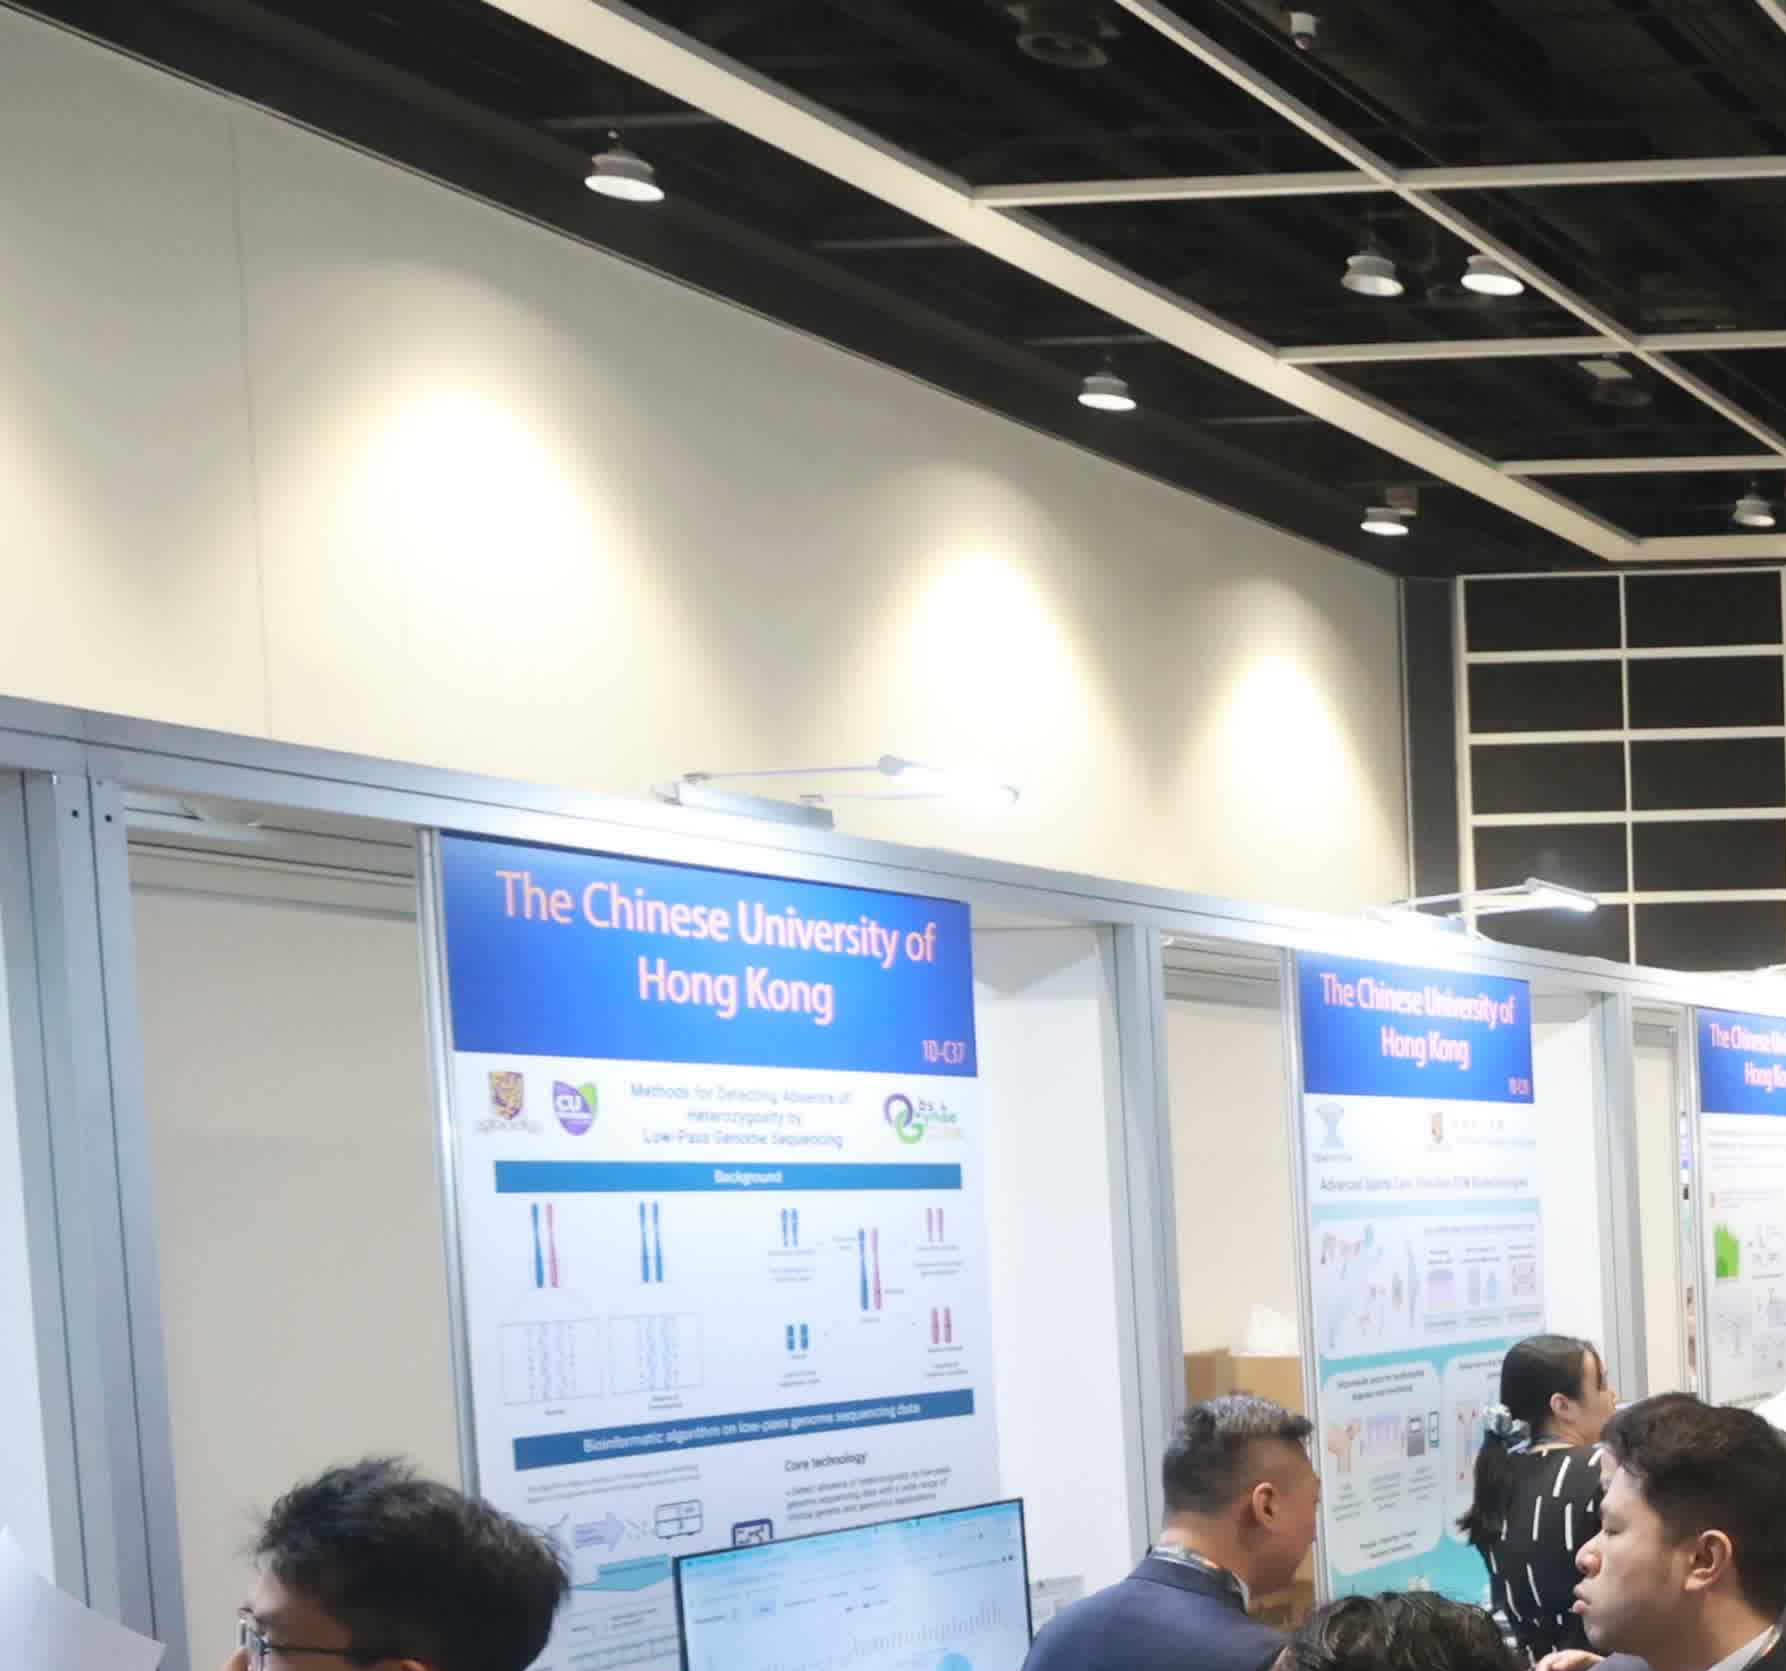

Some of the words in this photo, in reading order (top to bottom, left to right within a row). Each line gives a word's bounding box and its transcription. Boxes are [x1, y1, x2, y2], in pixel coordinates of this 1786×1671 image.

[496, 871, 573, 924] The
[582, 881, 730, 942] Chinese
[737, 903, 900, 968] University
[906, 922, 937, 962] of
[638, 956, 739, 1019] Hong
[745, 968, 835, 1025] Kong
[1320, 972, 1355, 1008] The
[1357, 977, 1424, 1015] Chinese
[1424, 985, 1499, 1030] University
[1500, 996, 1516, 1025] of
[1380, 1024, 1427, 1069] Hong
[1428, 1029, 1471, 1071] Kong
[1709, 1023, 1731, 1048] The
[1731, 1024, 1770, 1052] Chinese
[1744, 1060, 1773, 1093] Hong
[713, 1167, 784, 1186] Background
[784, 1458, 809, 1473] Core
[811, 1450, 869, 1470] technology
